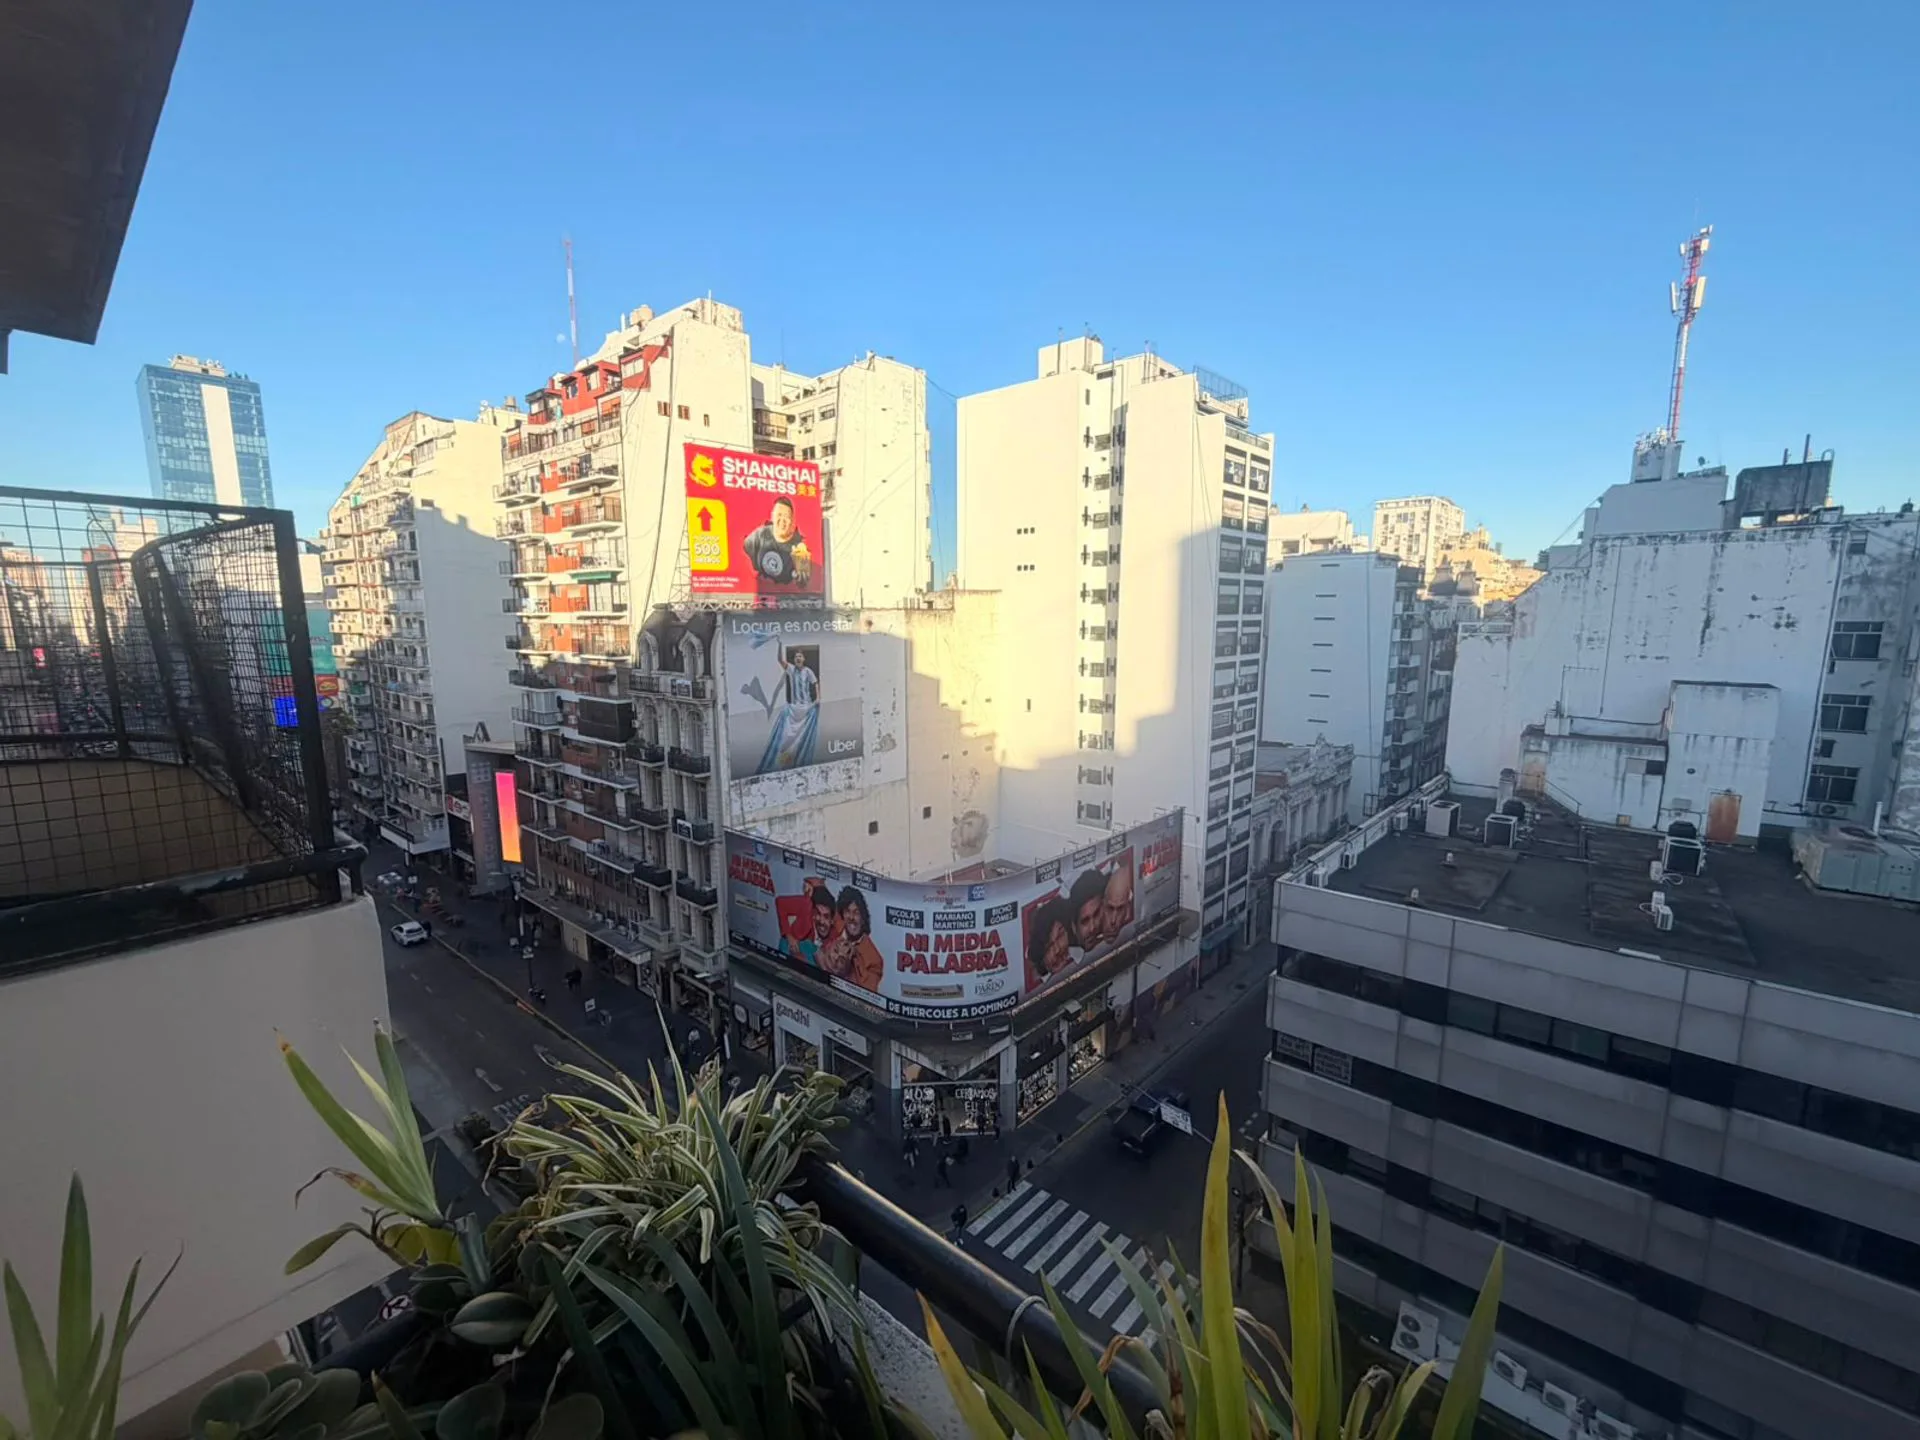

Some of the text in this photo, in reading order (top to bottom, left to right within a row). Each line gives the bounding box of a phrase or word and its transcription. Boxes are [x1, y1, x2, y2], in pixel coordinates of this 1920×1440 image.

[722, 456, 816, 484] SHANGHAI
[723, 473, 797, 495] EXPRESS
[695, 544, 720, 556] 500
[732, 619, 853, 635] Locura es no estar
[828, 739, 857, 754] Uber
[935, 912, 974, 921] MARIANO
[992, 904, 1012, 916] BICHO
[905, 929, 1002, 953] NI MEDIA
[897, 947, 1009, 974] PALABRA
[775, 1002, 810, 1028] gandhi
[889, 1001, 901, 1012] DE
[961, 1008, 969, 1017] A
[971, 997, 1017, 1015] DOMINGO
